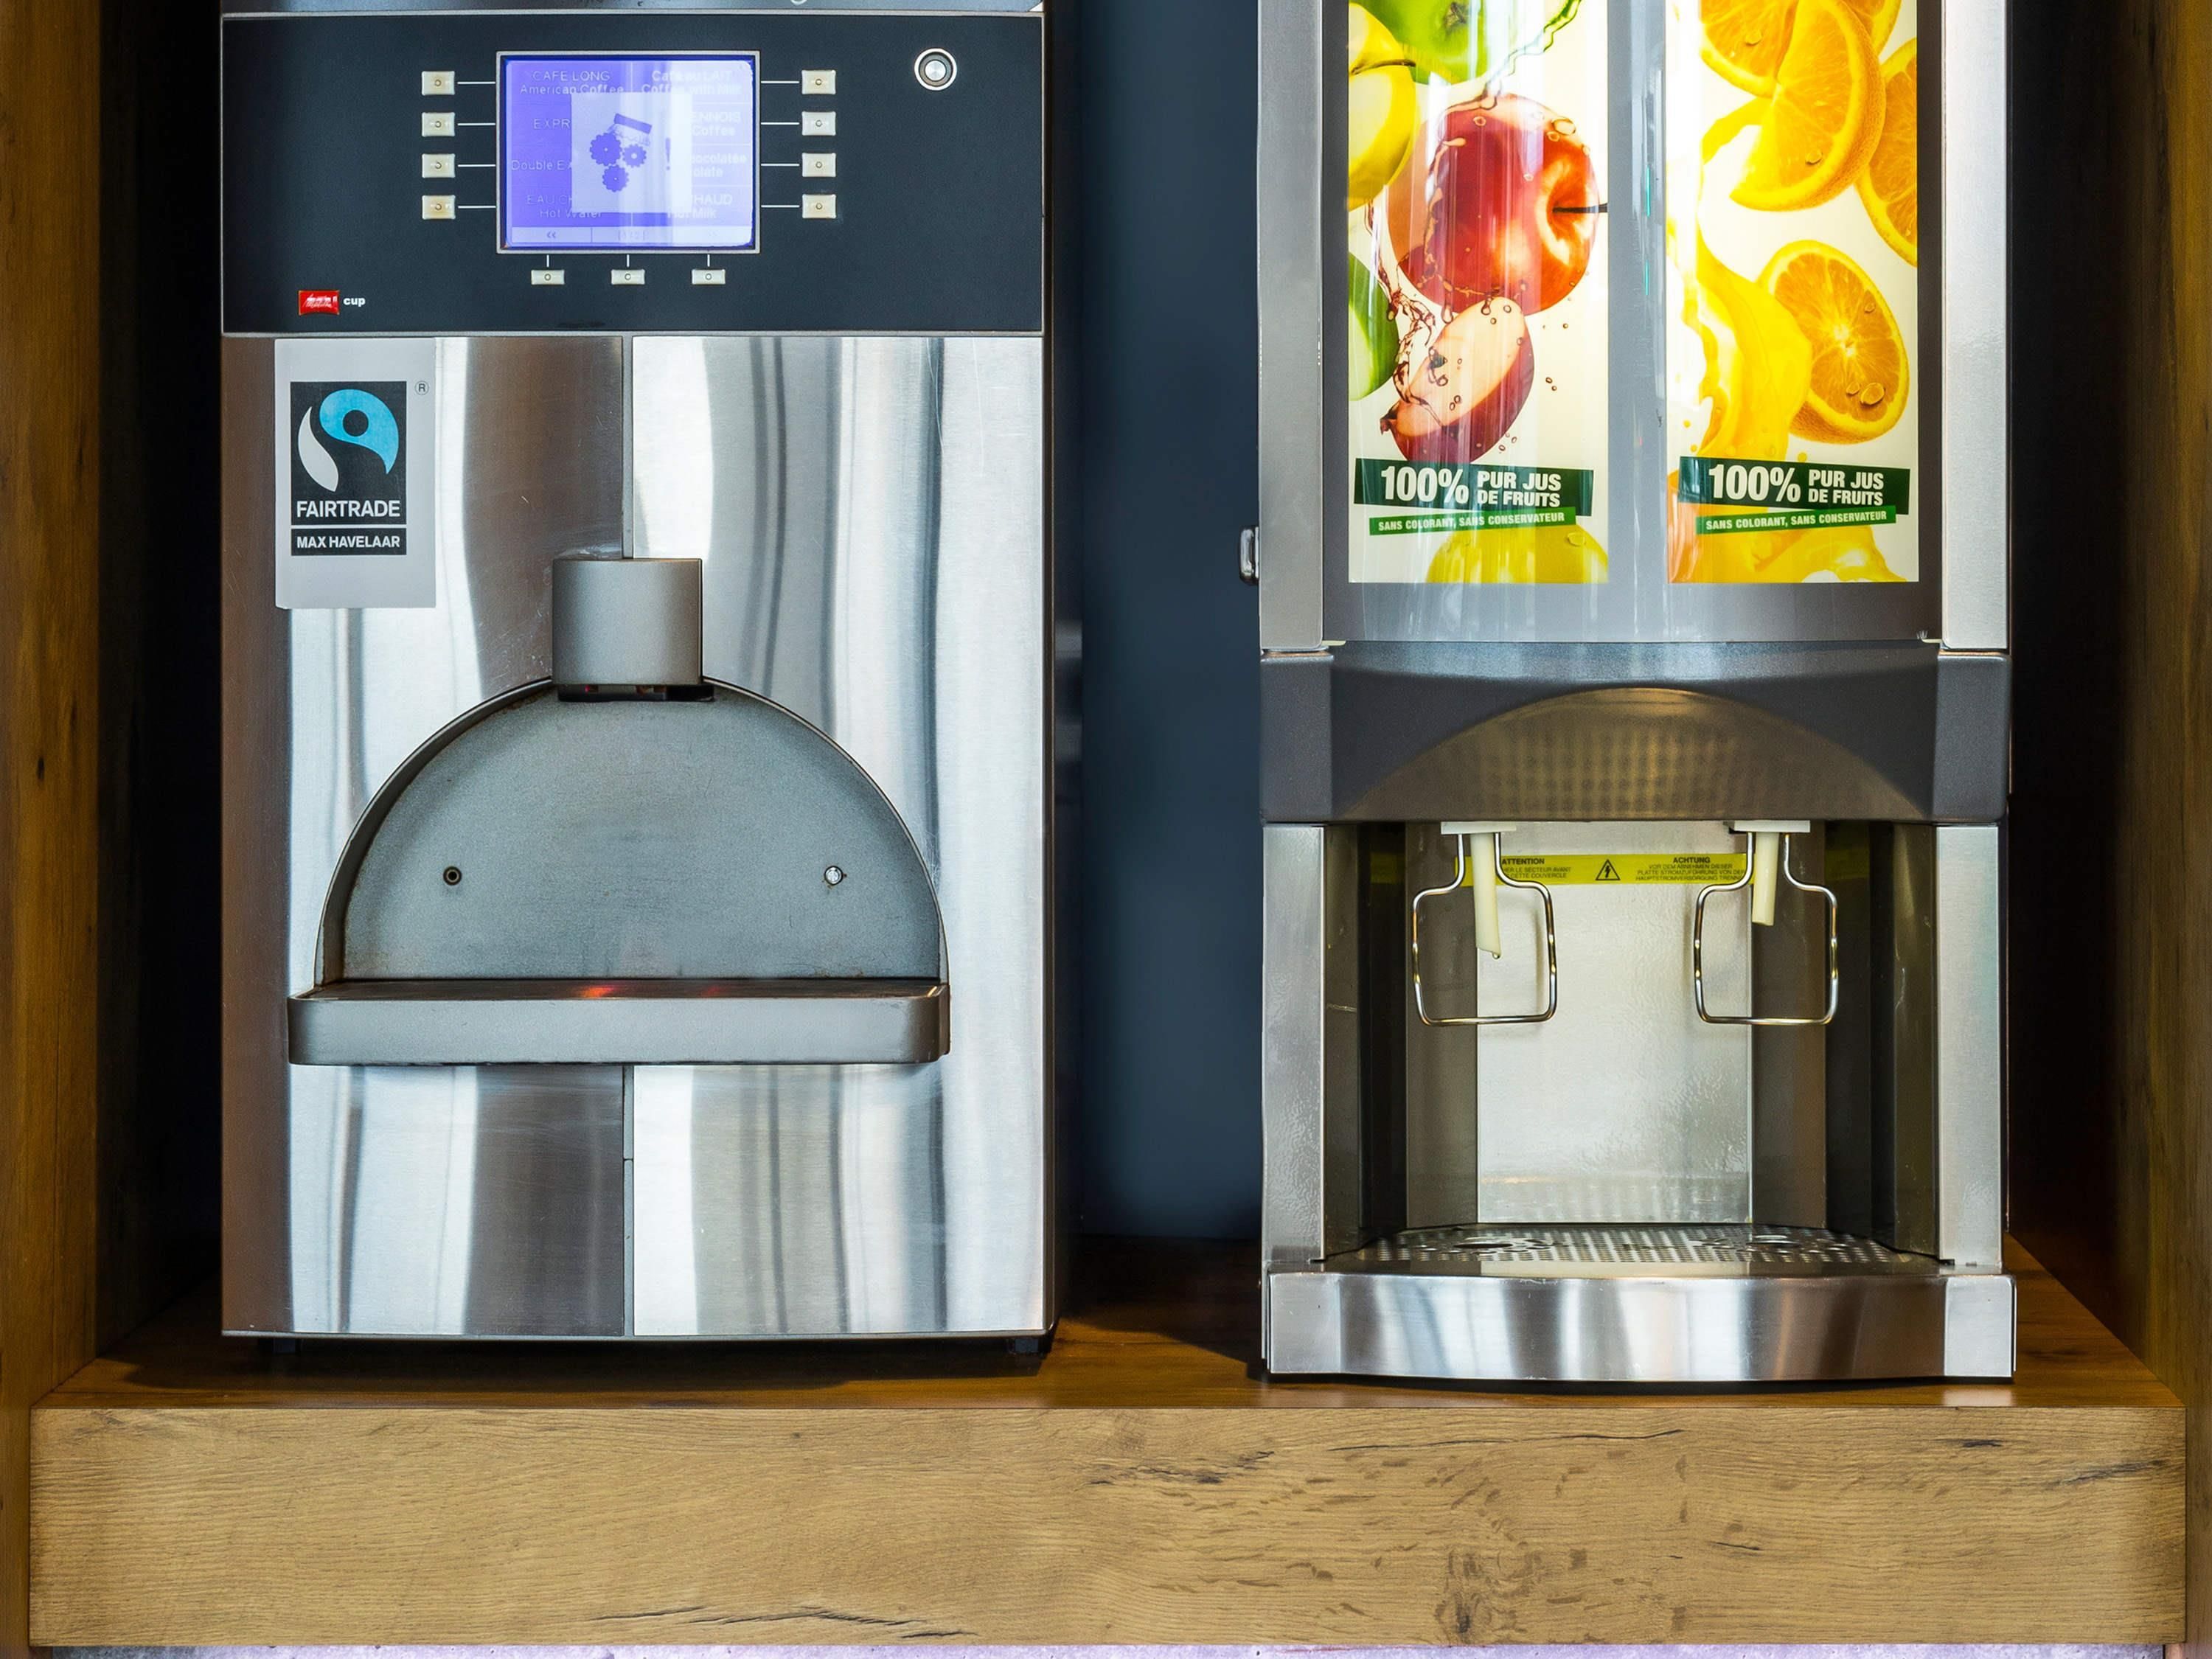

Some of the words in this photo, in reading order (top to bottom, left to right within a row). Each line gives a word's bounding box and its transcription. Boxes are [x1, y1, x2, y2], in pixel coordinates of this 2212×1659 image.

[532, 71, 568, 81] CAFE
[572, 71, 610, 81] LONG
[520, 84, 577, 94] American
[580, 84, 624, 94] Coffee
[512, 160, 553, 170] Double
[526, 195, 554, 205] EAU
[343, 297, 366, 307] cup
[1381, 465, 1470, 504] 100%
[1477, 470, 1517, 490] PUR
[1522, 473, 1562, 492] JUS
[1708, 464, 1801, 503] 100%
[1808, 469, 1846, 488] PUR
[1850, 471, 1885, 490] JUS
[1477, 490, 1498, 504] DE
[1503, 490, 1561, 507] FRUITS
[1808, 488, 1829, 504] DE
[1832, 490, 1884, 506] FRUITS
[296, 500, 401, 518] FAIRTRADE
[1378, 521, 1403, 531] SANS
[1405, 518, 1457, 530] COLORANT,
[1459, 516, 1486, 527] SANS
[1488, 512, 1565, 526] CONSERVATEUR
[1705, 520, 1733, 530] SANS
[1736, 515, 1788, 529] COLORANT,
[1790, 514, 1817, 526] SANS
[1818, 510, 1888, 524] CONSERVATEUR
[296, 535, 326, 549] MAX
[329, 535, 400, 549] HAVELAAR
[1501, 858, 1545, 866] ATTENTION
